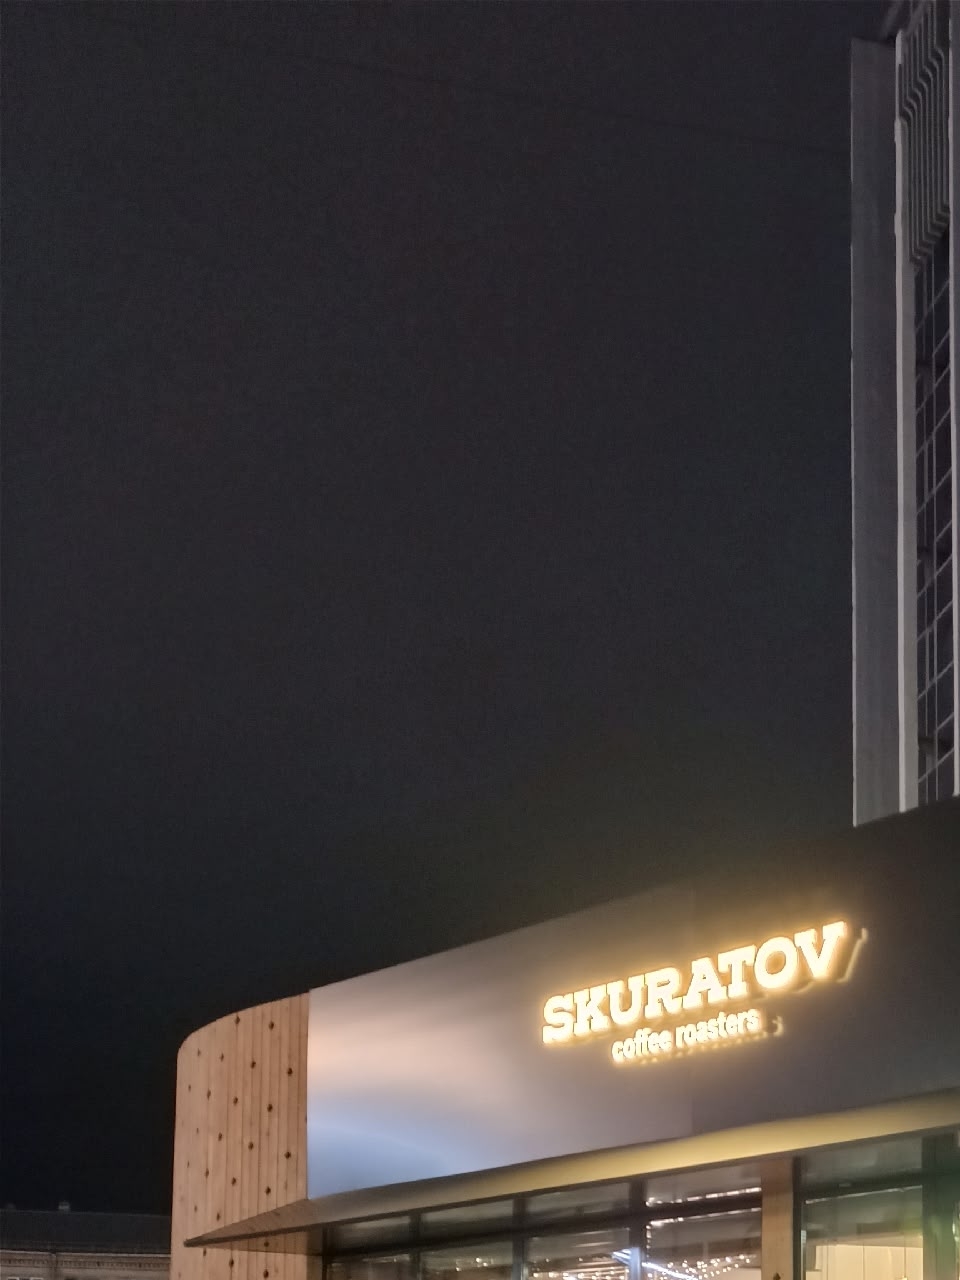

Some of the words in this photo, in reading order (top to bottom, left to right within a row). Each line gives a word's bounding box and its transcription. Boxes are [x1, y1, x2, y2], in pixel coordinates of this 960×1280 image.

[542, 920, 848, 1044] SKURATOV
[611, 1028, 673, 1063] coffee
[675, 1008, 760, 1047] roasters
